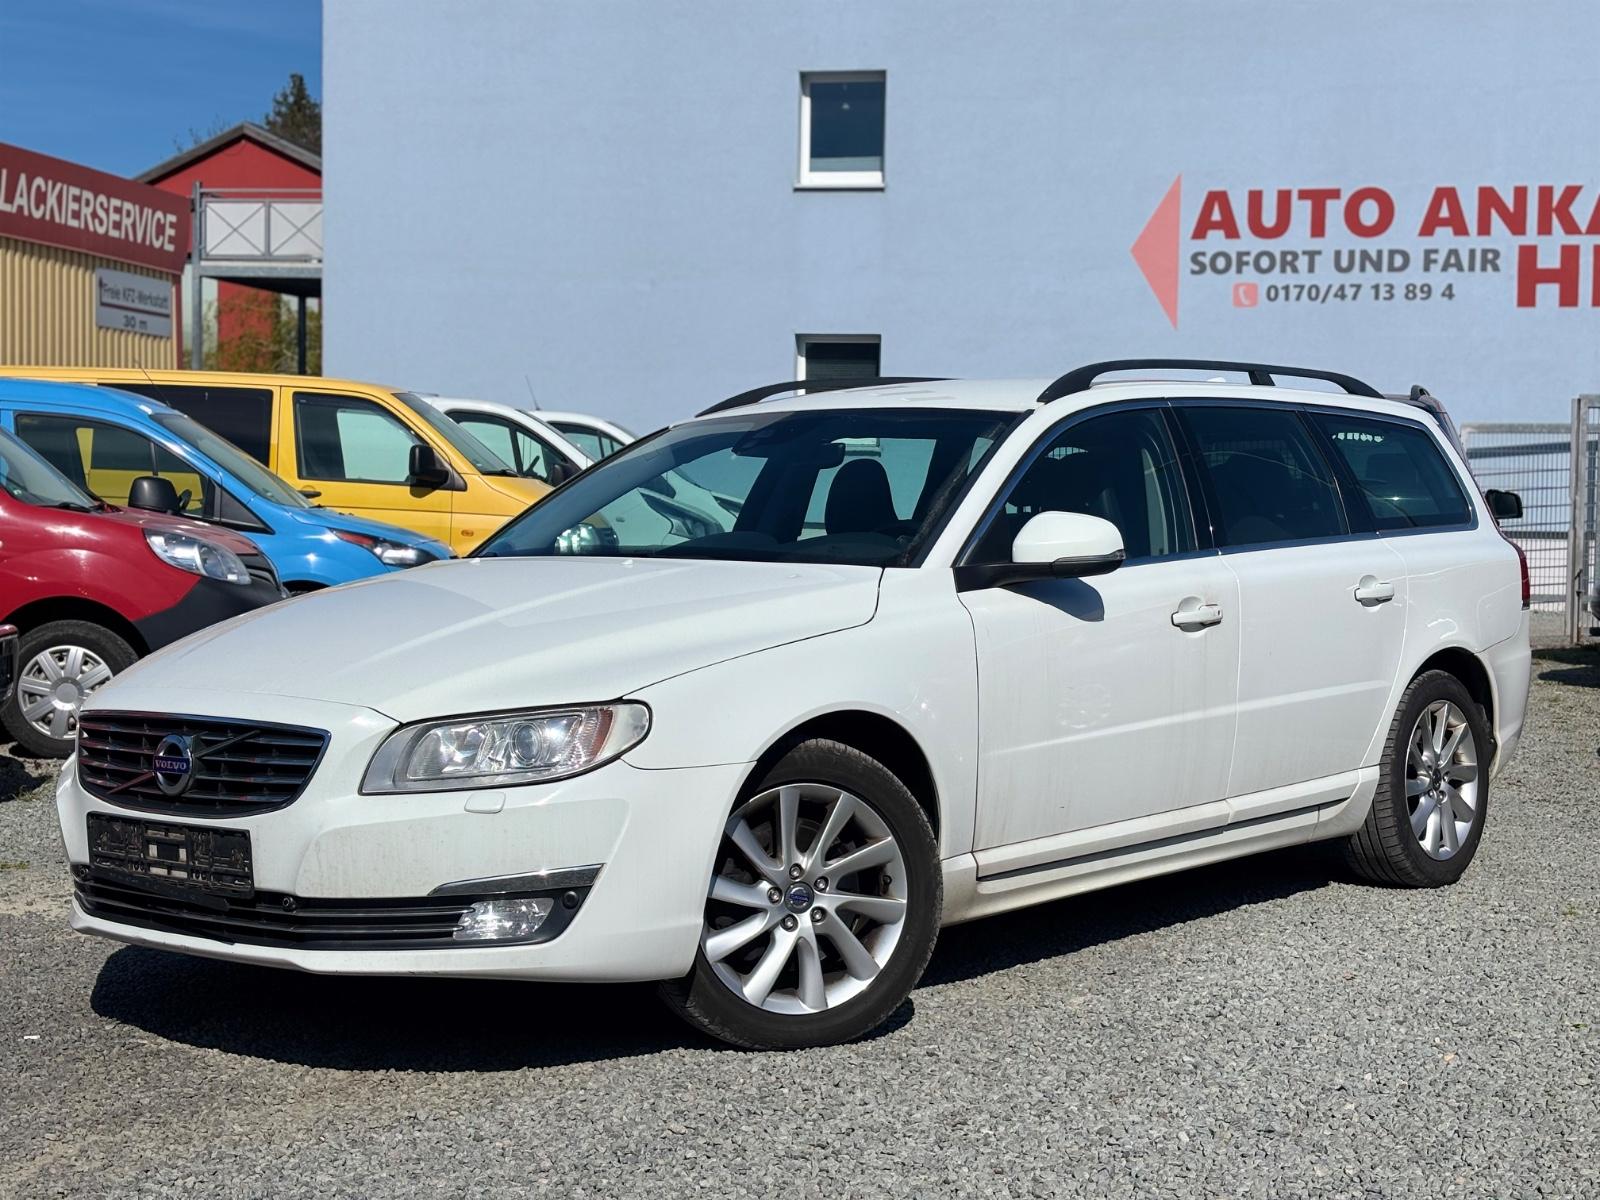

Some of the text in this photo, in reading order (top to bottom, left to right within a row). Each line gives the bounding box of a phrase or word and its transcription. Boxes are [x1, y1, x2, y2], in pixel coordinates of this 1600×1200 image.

[0, 168, 177, 252] LACKIERSERVICE
[1190, 186, 1395, 240] AUTO
[1190, 248, 1501, 275] SOFORT UND FAIR
[1265, 283, 1455, 304] 0170/47 13 89 4
[123, 314, 149, 331] 30 m
[155, 760, 187, 770] VOLVO
